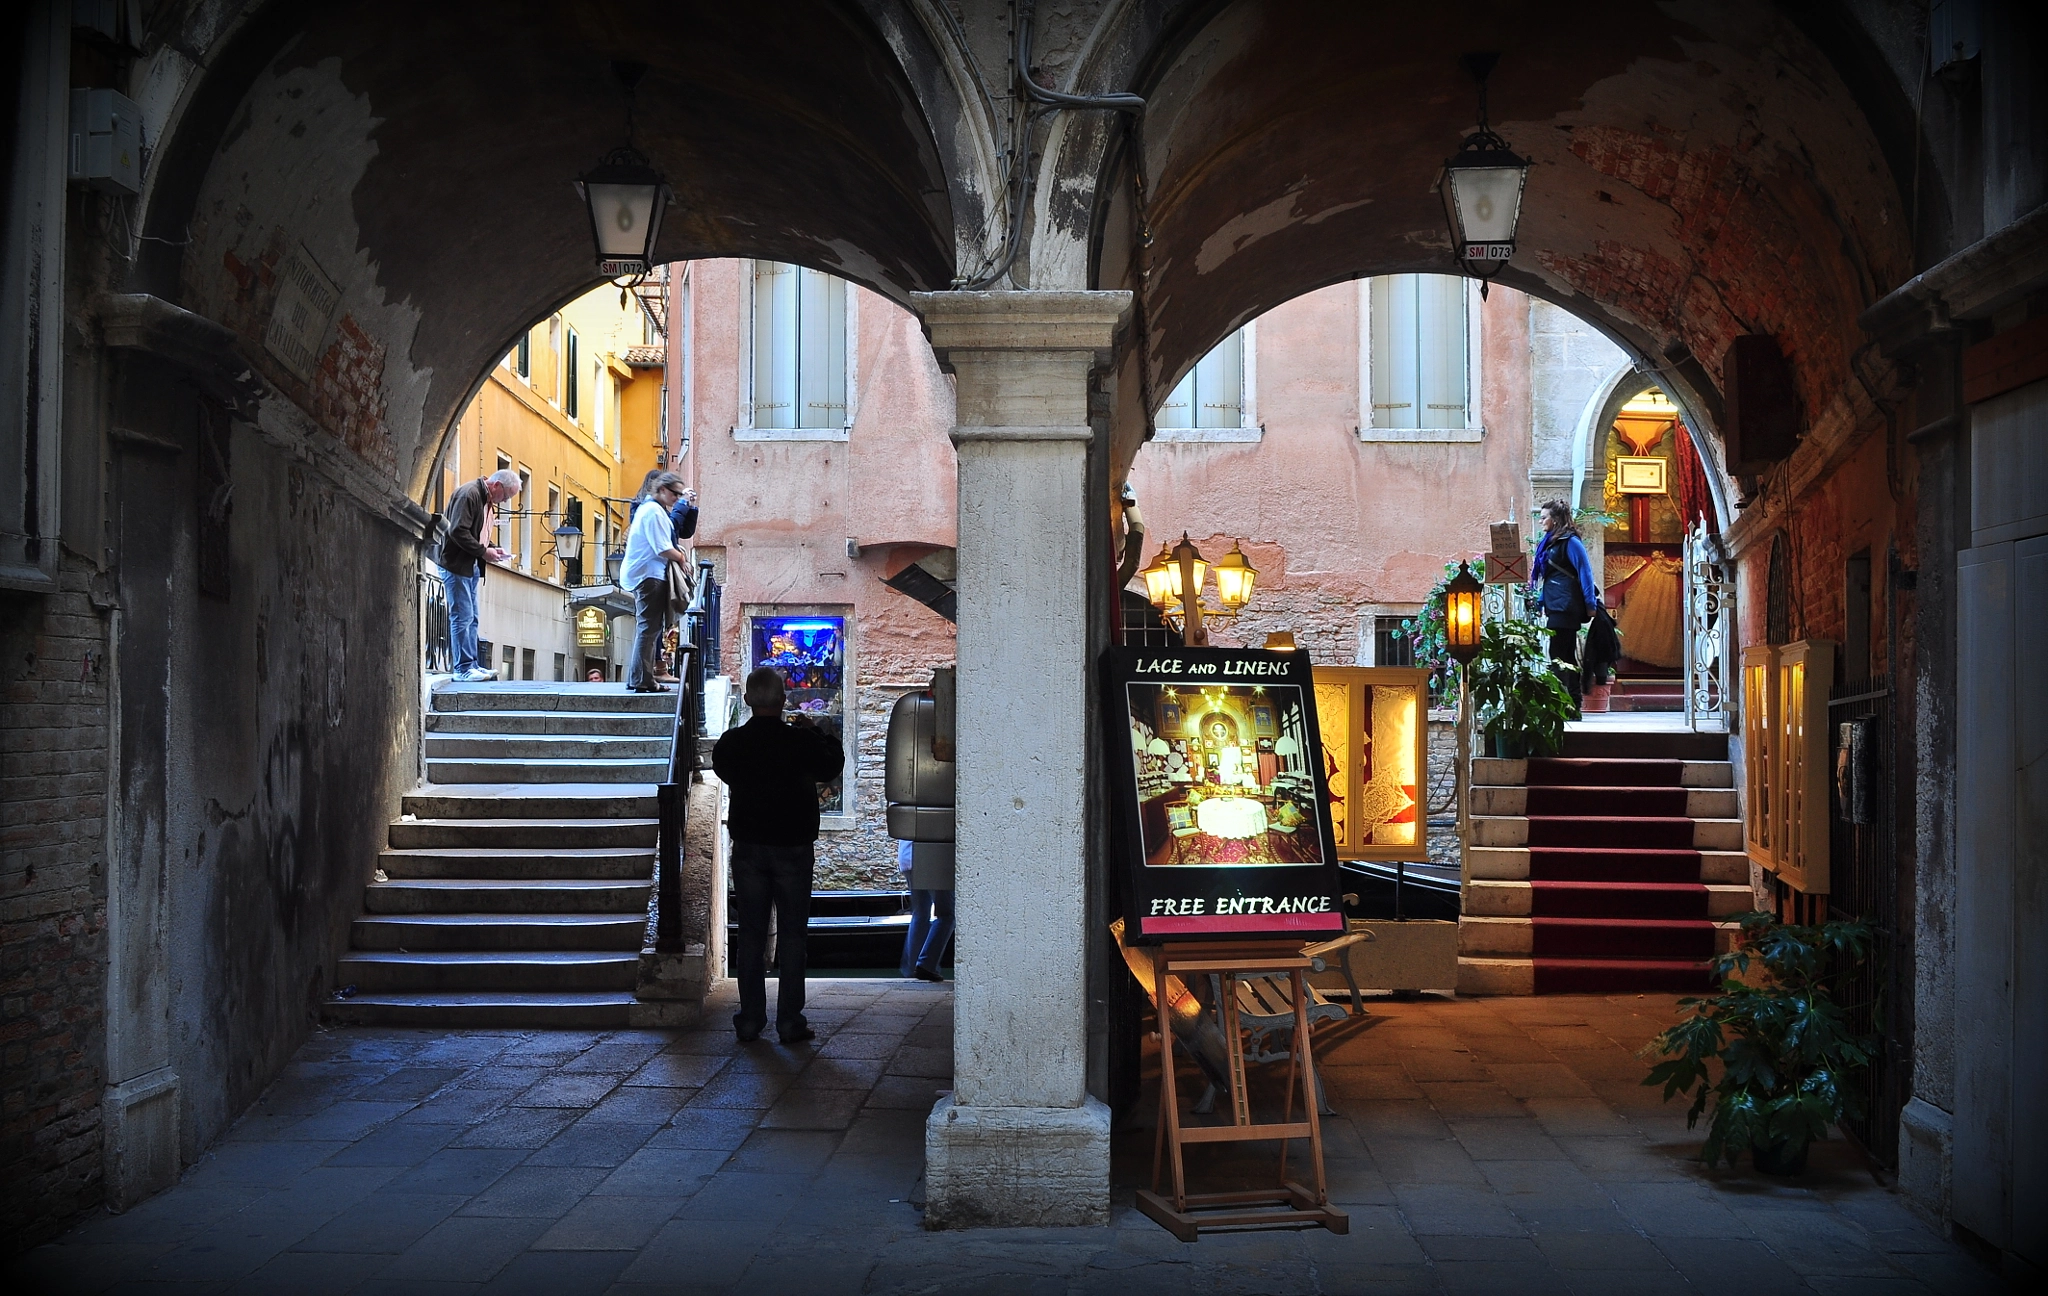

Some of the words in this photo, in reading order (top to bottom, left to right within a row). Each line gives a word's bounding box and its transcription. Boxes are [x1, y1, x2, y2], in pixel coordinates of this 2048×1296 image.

[1469, 246, 1485, 258] SM
[1491, 246, 1511, 258] 073
[602, 263, 618, 274] SM
[623, 263, 643, 274] 072
[291, 301, 308, 333] DEL
[1135, 658, 1183, 674] LACE
[1187, 663, 1217, 675] AND
[1223, 660, 1291, 676] LINENS
[1150, 898, 1205, 916] FREE
[1215, 896, 1331, 915] ENTRANCE
